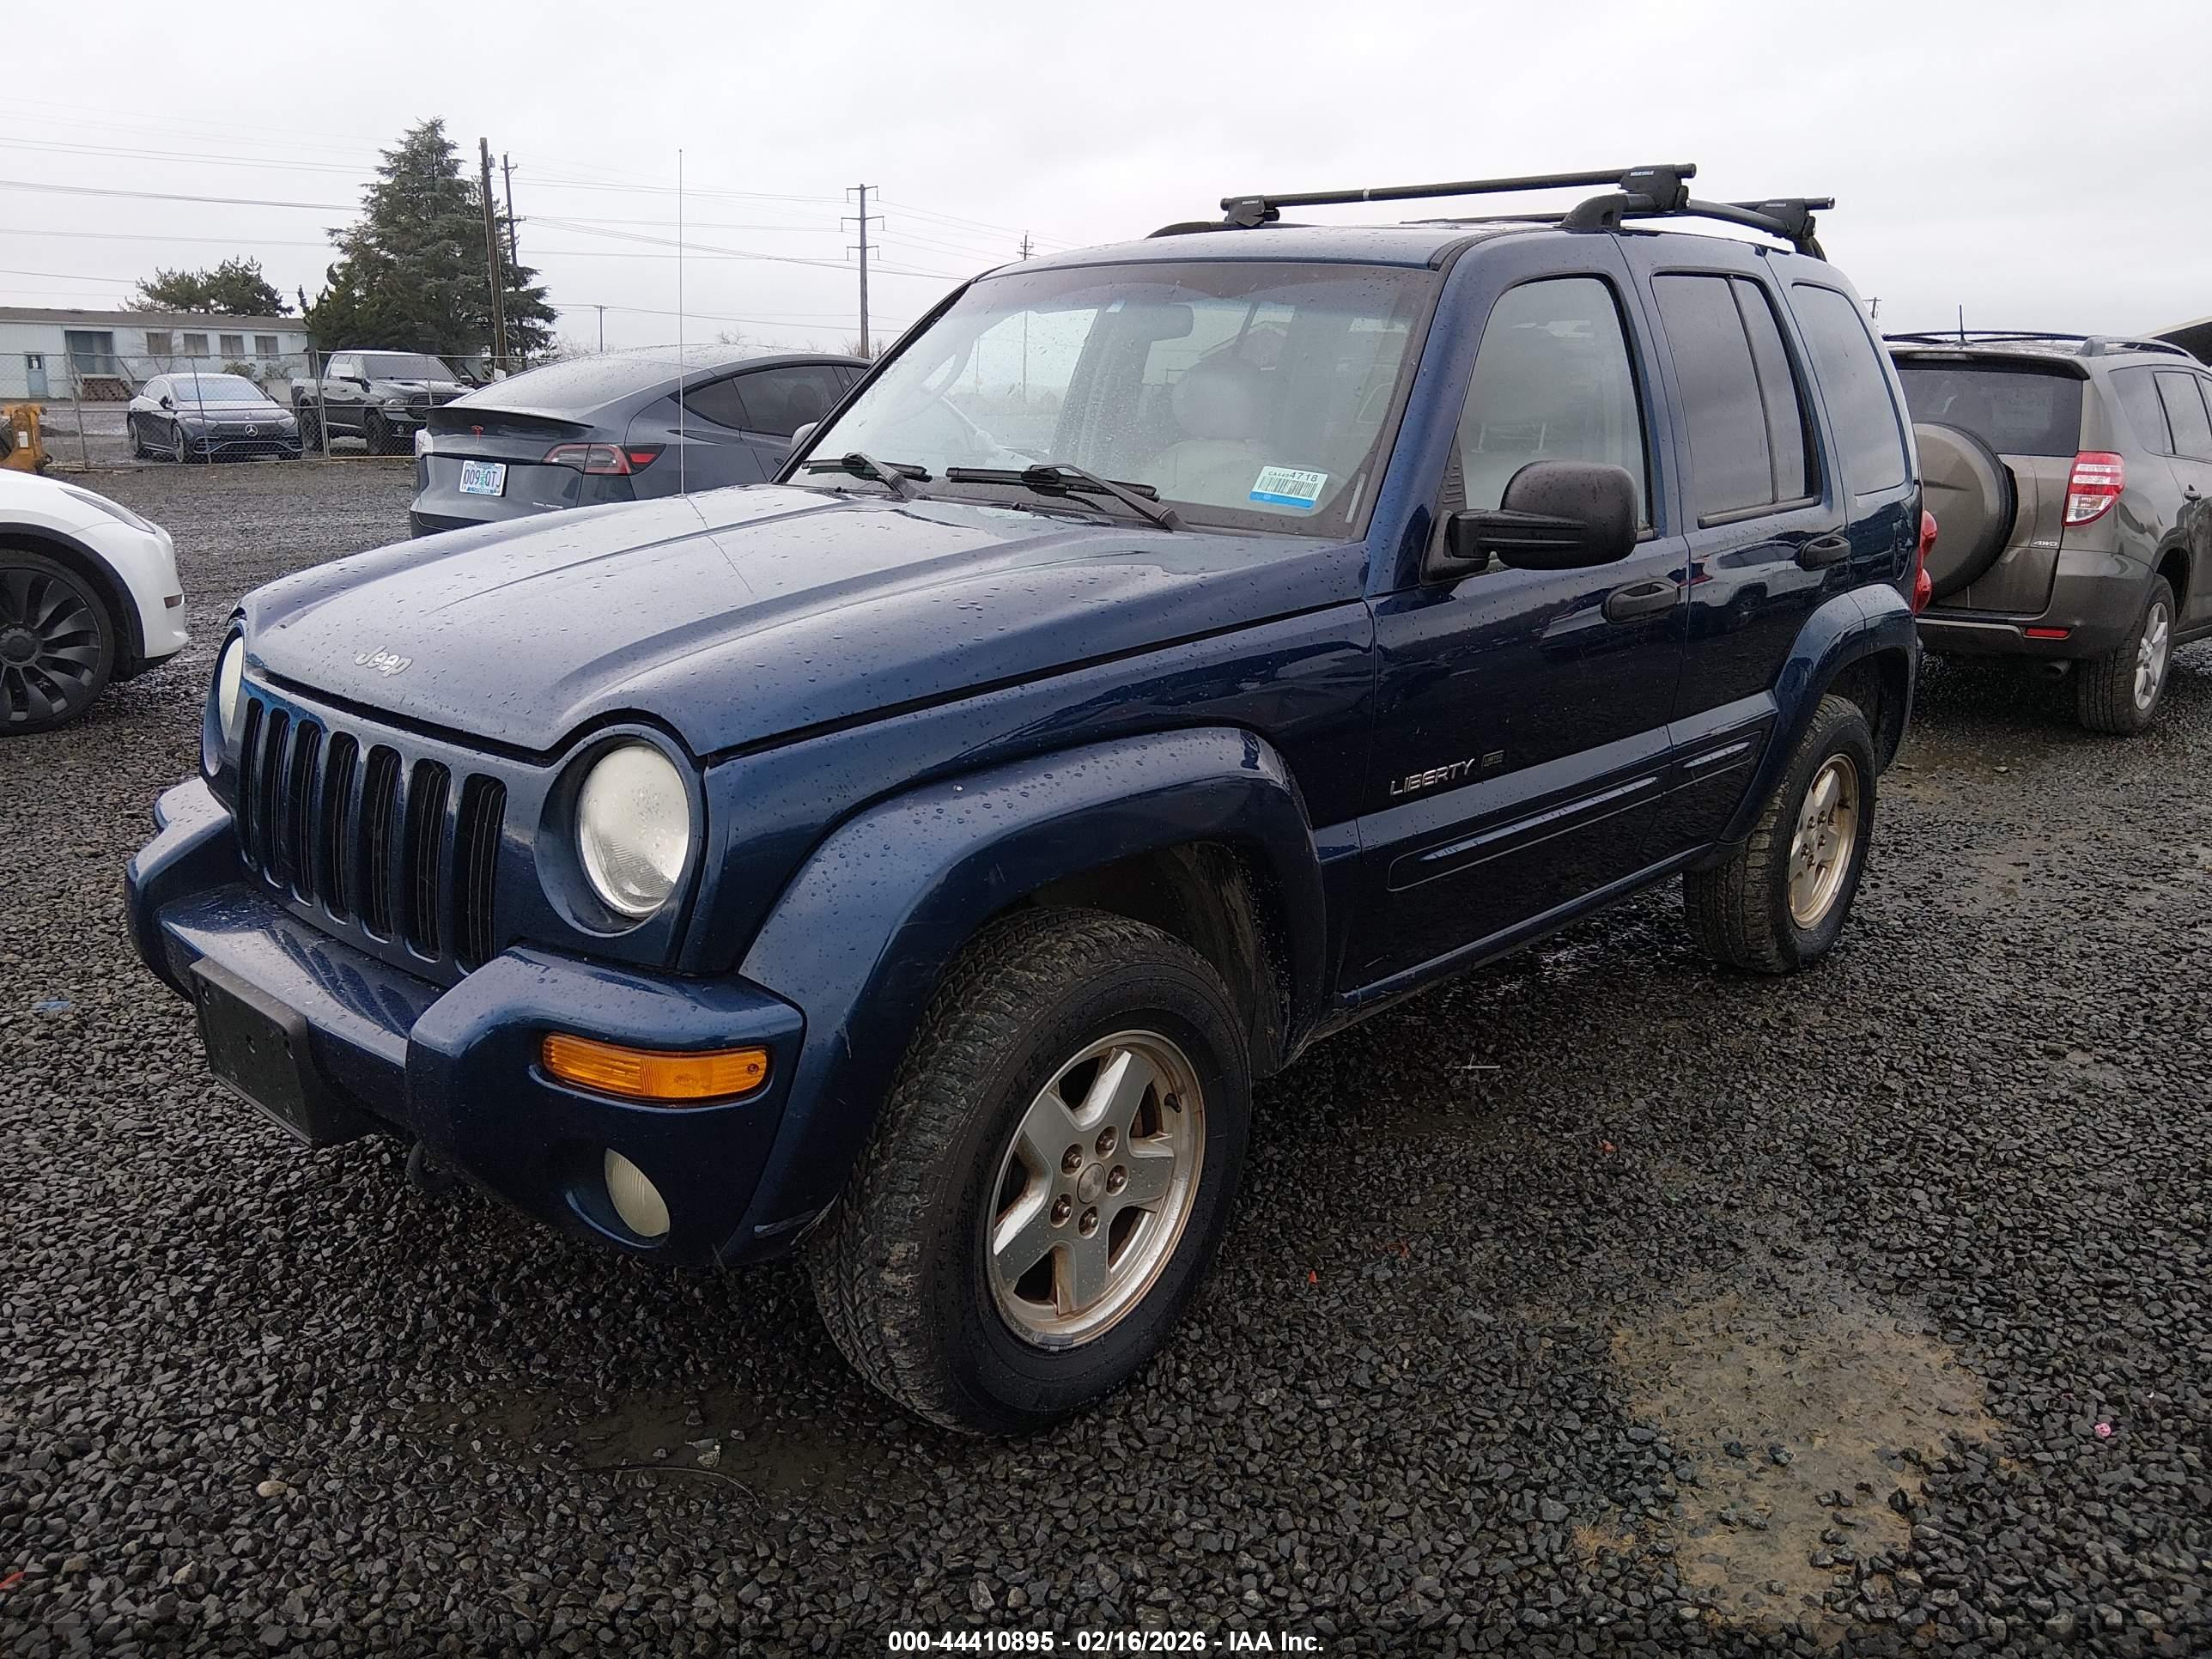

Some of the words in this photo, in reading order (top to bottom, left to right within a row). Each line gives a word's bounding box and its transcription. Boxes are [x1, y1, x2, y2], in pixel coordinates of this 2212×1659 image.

[464, 469, 481, 485] 009
[355, 645, 413, 678] Jeep
[1389, 758, 1475, 795] LIBERTY
